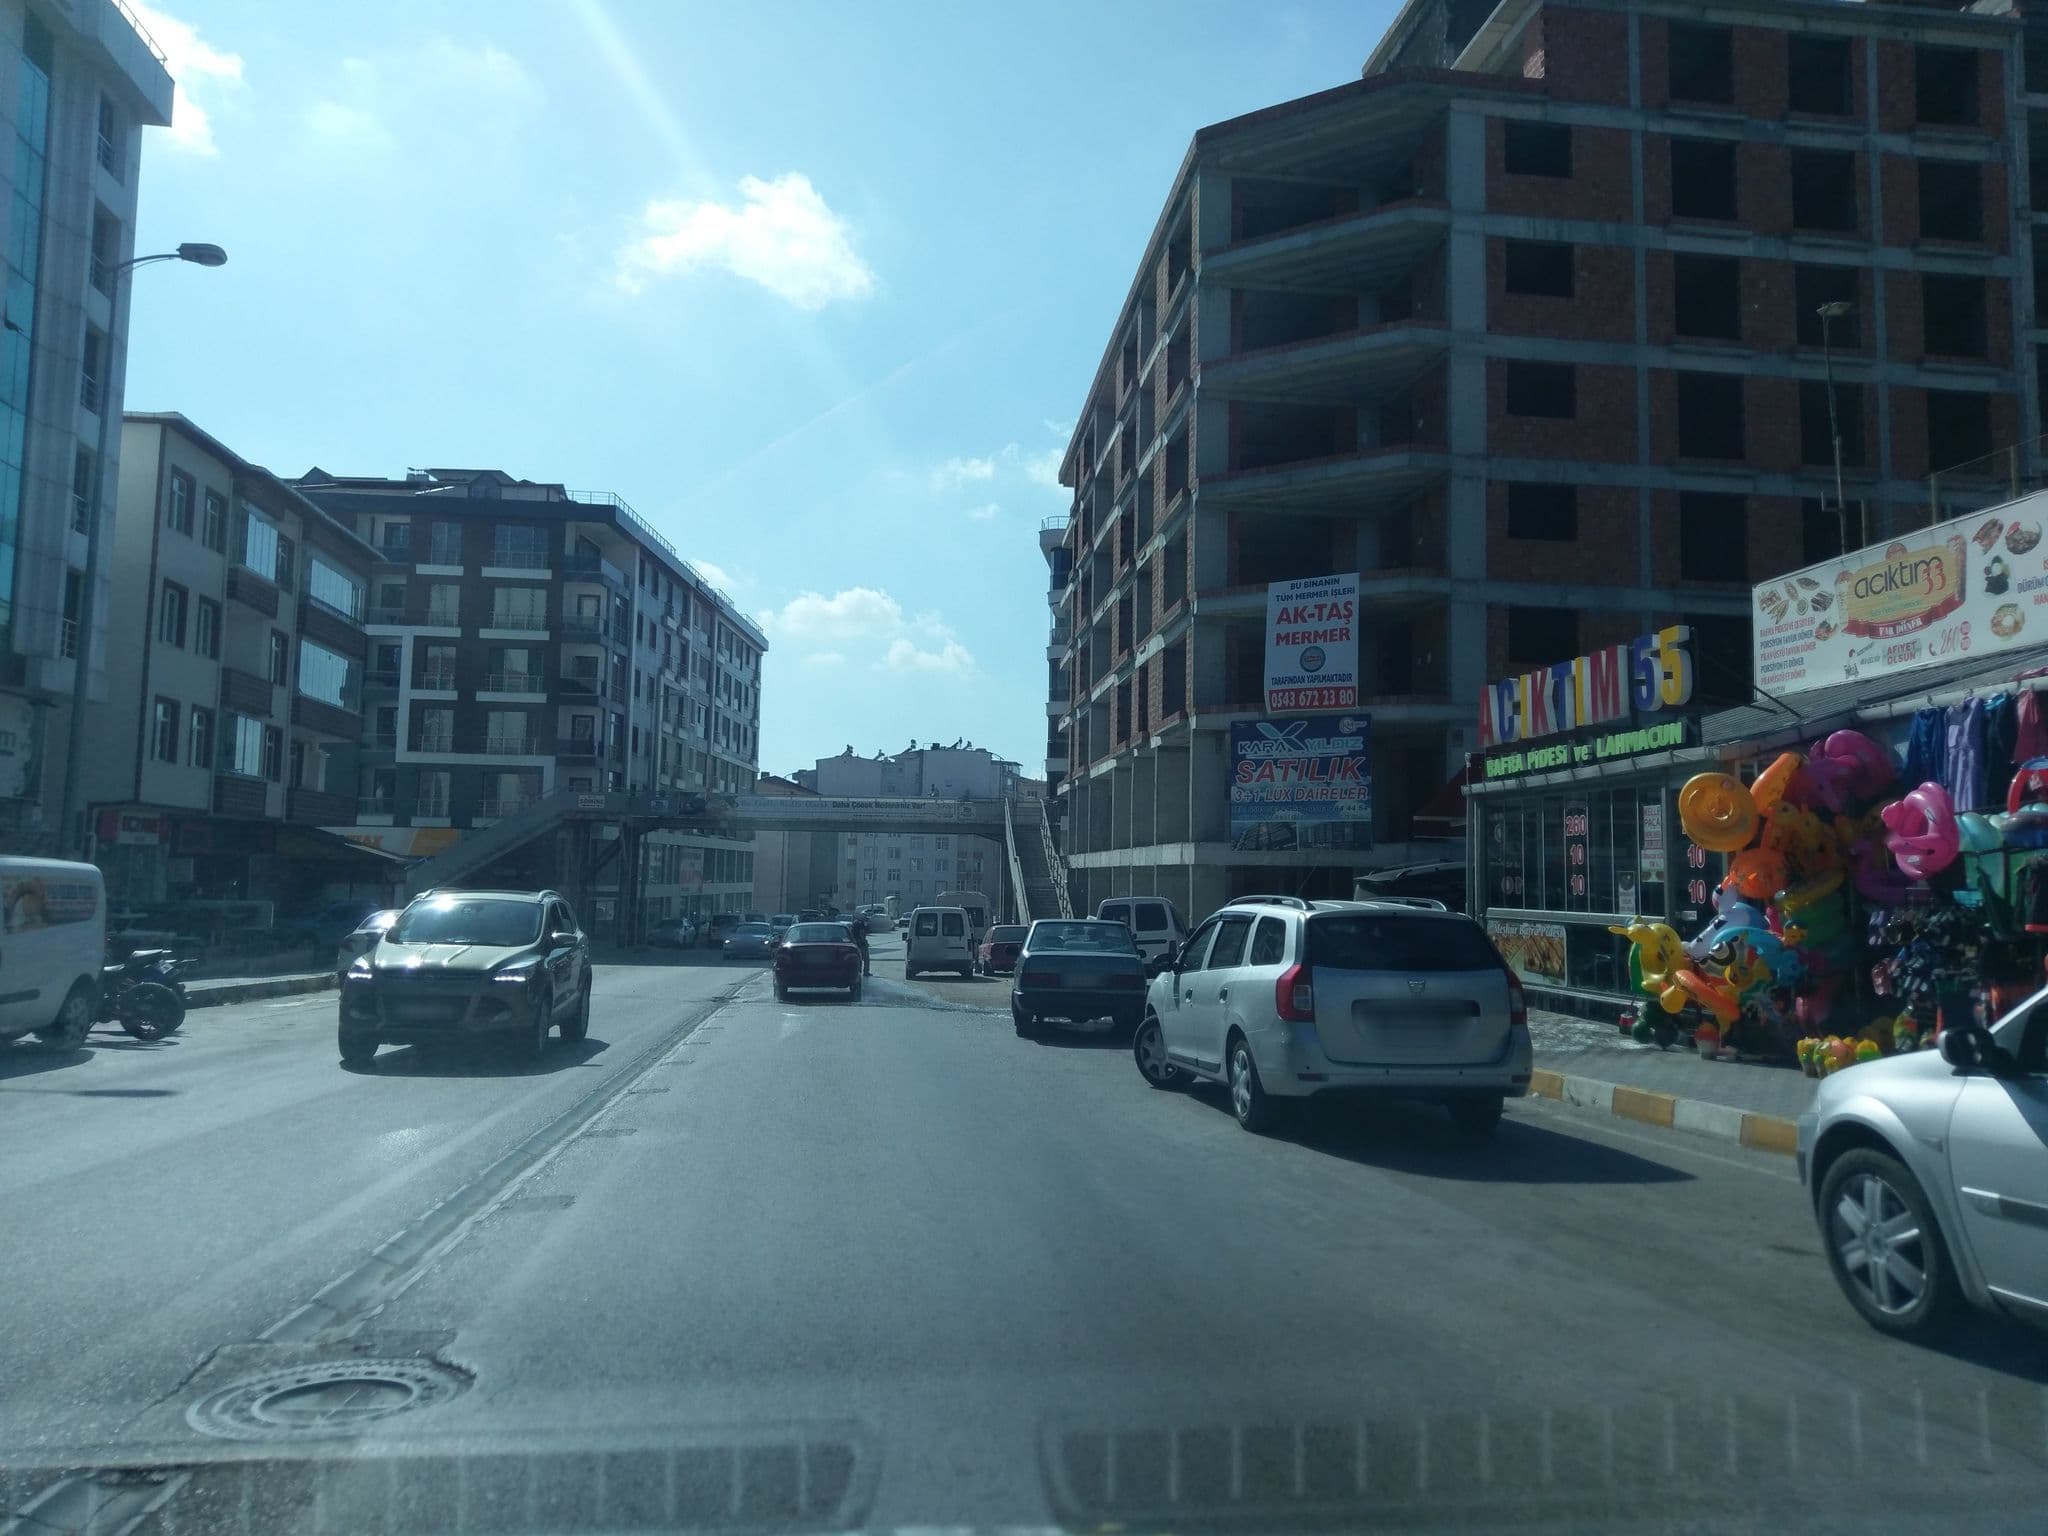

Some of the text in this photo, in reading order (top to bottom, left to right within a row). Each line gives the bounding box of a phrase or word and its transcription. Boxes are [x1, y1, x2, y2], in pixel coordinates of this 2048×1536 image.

[1290, 582, 1301, 590] BU
[1295, 591, 1329, 600] MERMER
[1331, 586, 1355, 599] İŞLERİ
[2017, 576, 2044, 593] DÜRÜM
[1275, 600, 1354, 625] AK-TAŞ
[1275, 627, 1351, 647] MERMER
[1887, 651, 1917, 665] OLSUN
[1271, 673, 1353, 686] TARAFINDAN YAPILMAKTADIR
[1478, 625, 1692, 747] ACIKTIM 55
[1299, 690, 1320, 706] 672
[1322, 689, 1336, 706] 23
[1339, 688, 1354, 705] 80
[1486, 754, 1522, 778] BAFRA
[1573, 745, 1589, 762] ve
[1596, 721, 1683, 758] LAHMACUN
[1235, 757, 1367, 784] SATILIK
[1235, 787, 1262, 803] 3+1
[1566, 815, 1587, 836] 260
[1570, 844, 1584, 865] 10
[1688, 844, 1706, 868] 10
[1570, 874, 1585, 896] 10
[1688, 880, 1706, 904] 10
